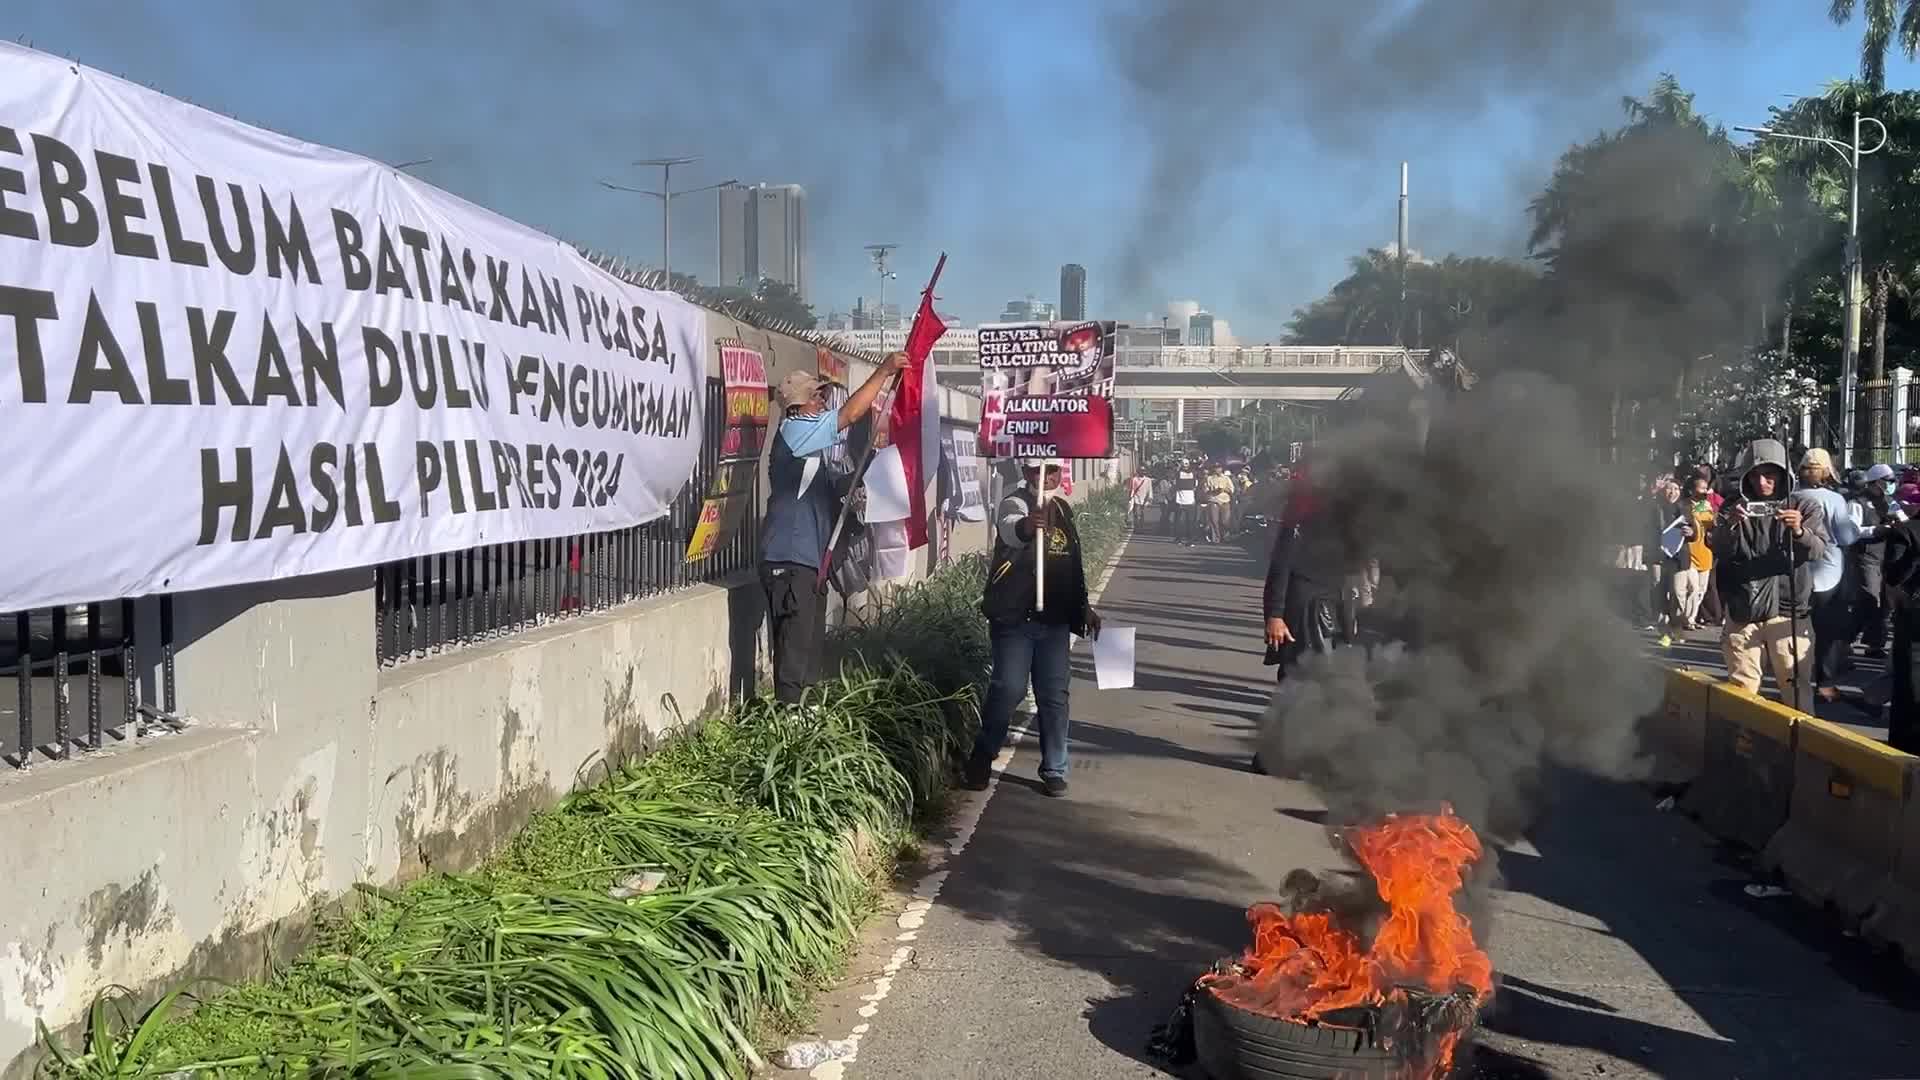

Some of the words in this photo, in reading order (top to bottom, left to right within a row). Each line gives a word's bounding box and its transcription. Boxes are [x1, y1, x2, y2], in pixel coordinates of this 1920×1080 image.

[331, 208, 570, 342] BATALKAN
[573, 284, 676, 373] PUASA,
[980, 330, 1039, 341] CLEVER
[981, 341, 1058, 354] CHEATING
[981, 353, 1080, 367] CALCULATOR
[362, 326, 489, 412] DULU
[503, 350, 692, 440] PENGUMUMAN
[196, 440, 400, 545] HASIL
[416, 440, 561, 518] PILPRES
[562, 449, 624, 506] 2024
